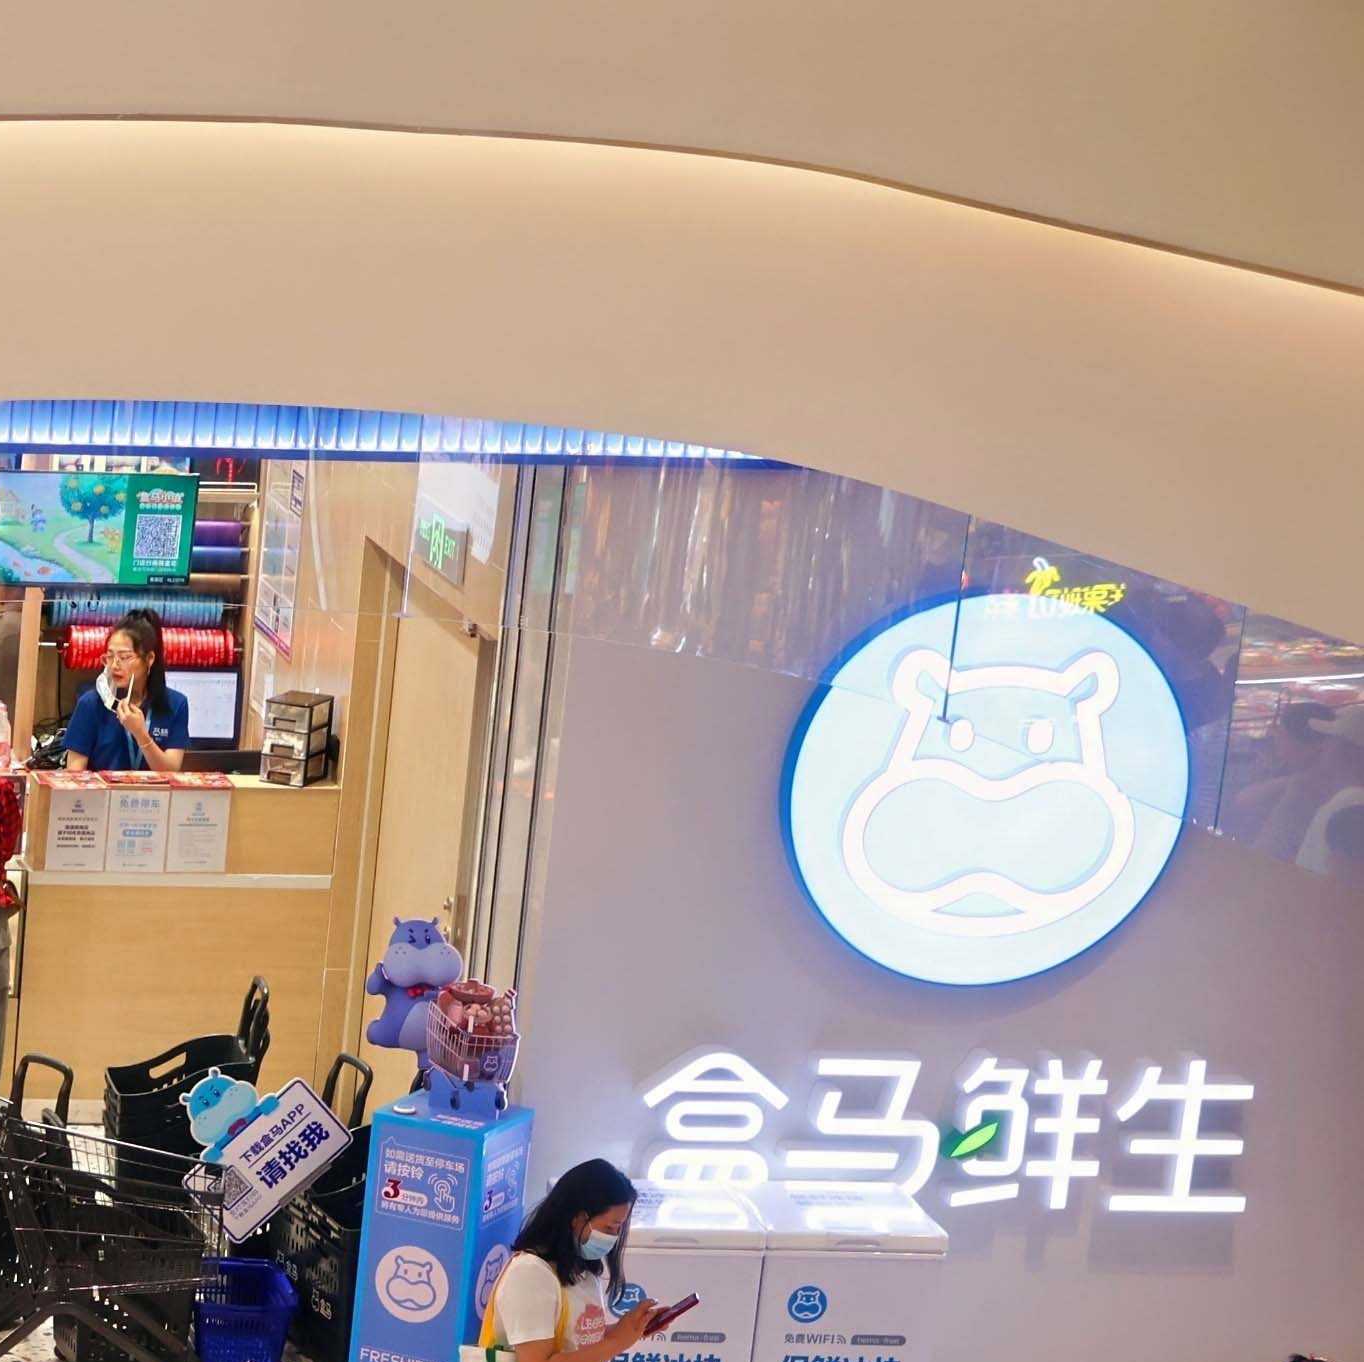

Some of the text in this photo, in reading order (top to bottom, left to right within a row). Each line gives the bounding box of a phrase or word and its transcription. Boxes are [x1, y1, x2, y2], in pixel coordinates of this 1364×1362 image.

[239, 1103, 306, 1163] 下载盒马APP
[255, 1120, 331, 1189] 请找我
[643, 1050, 1255, 1213] 盒马鲜生
[383, 1161, 425, 1181] 请按铃
